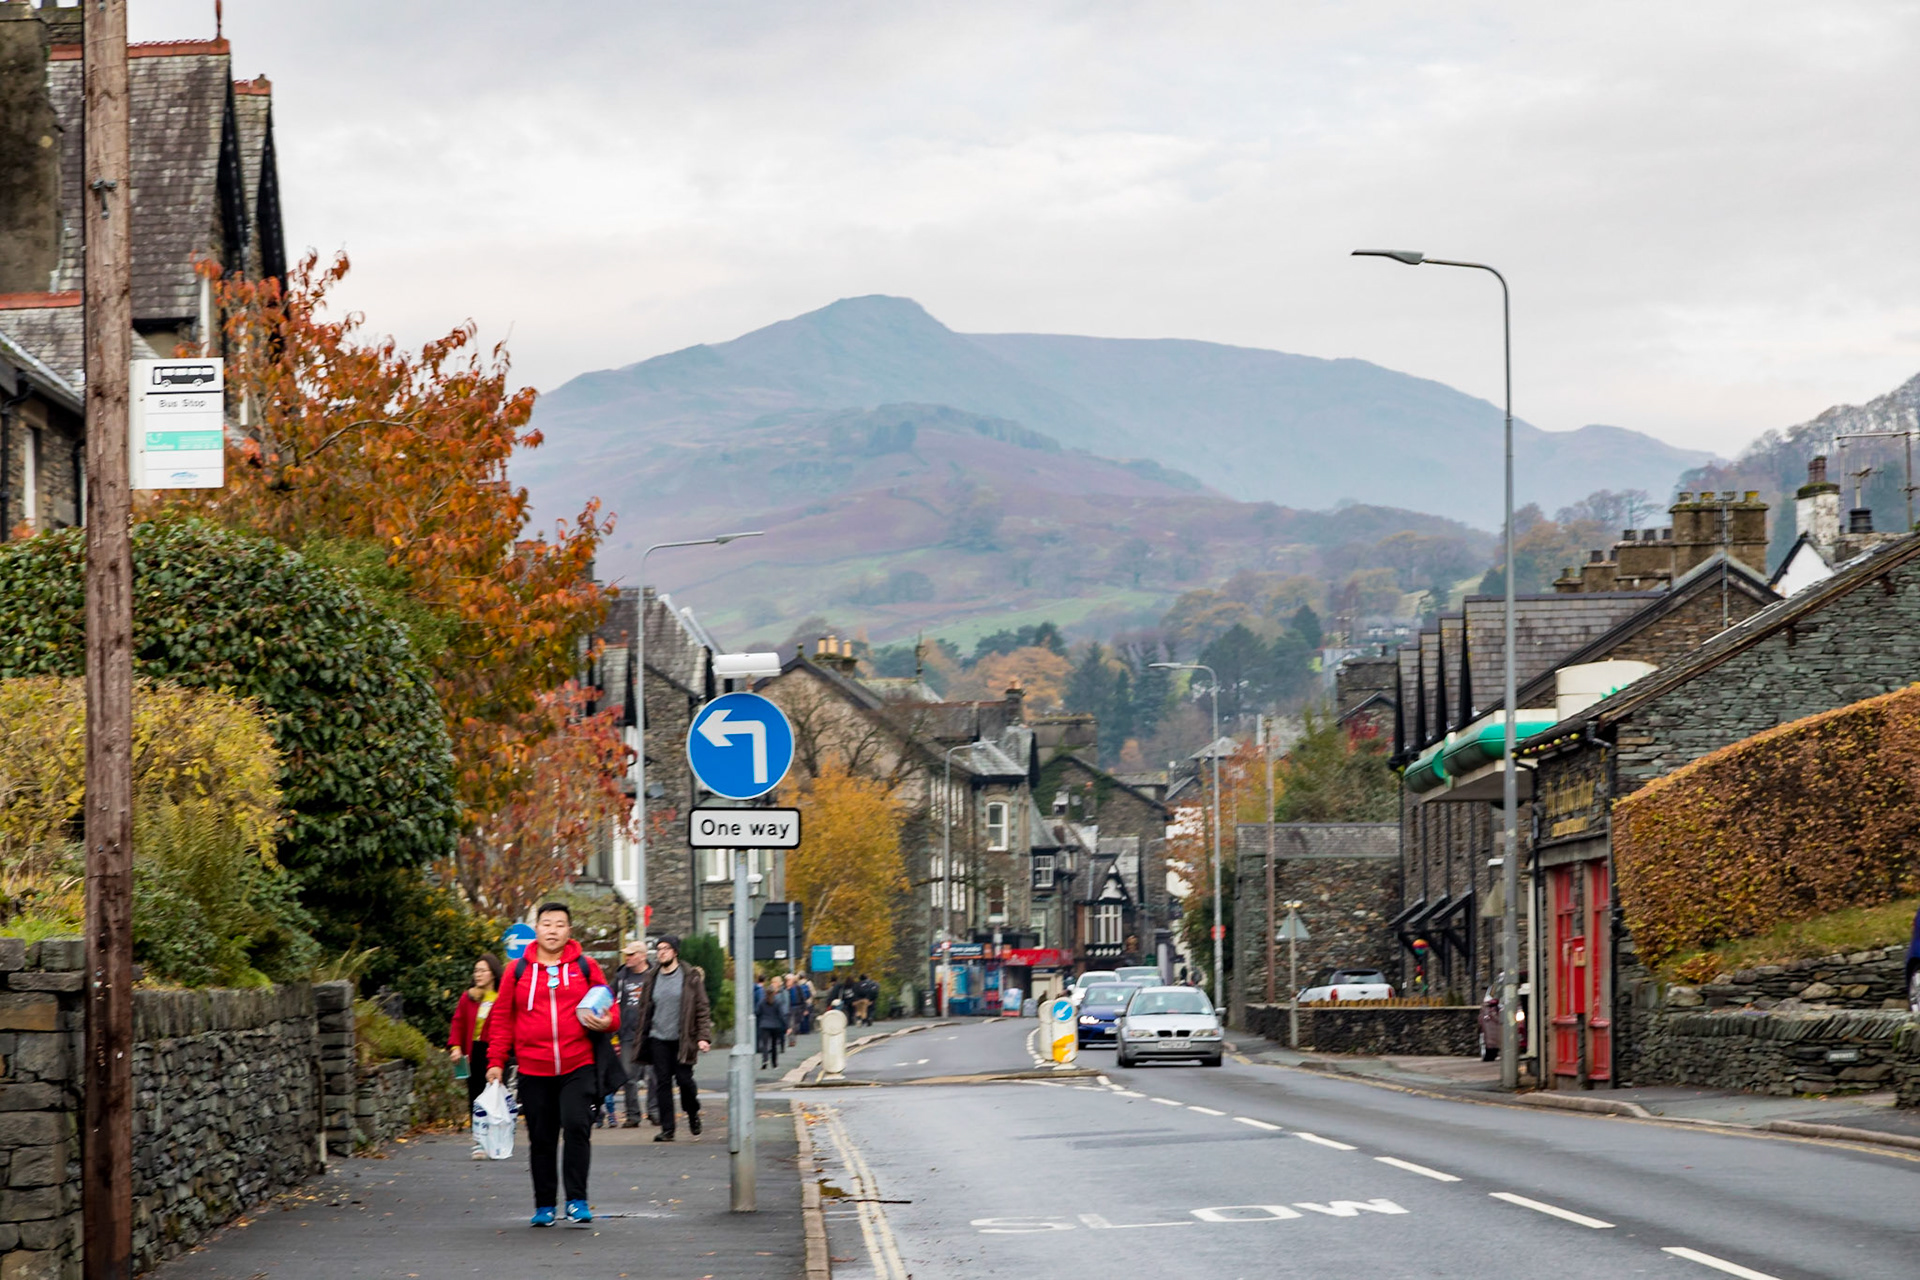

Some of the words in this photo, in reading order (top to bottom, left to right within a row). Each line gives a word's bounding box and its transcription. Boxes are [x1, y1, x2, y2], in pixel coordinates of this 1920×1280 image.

[160, 399, 178, 408] Bus
[183, 398, 206, 408] Stop
[701, 819, 741, 836] One
[750, 823, 790, 839] way
[970, 1199, 1409, 1233] SLOW
